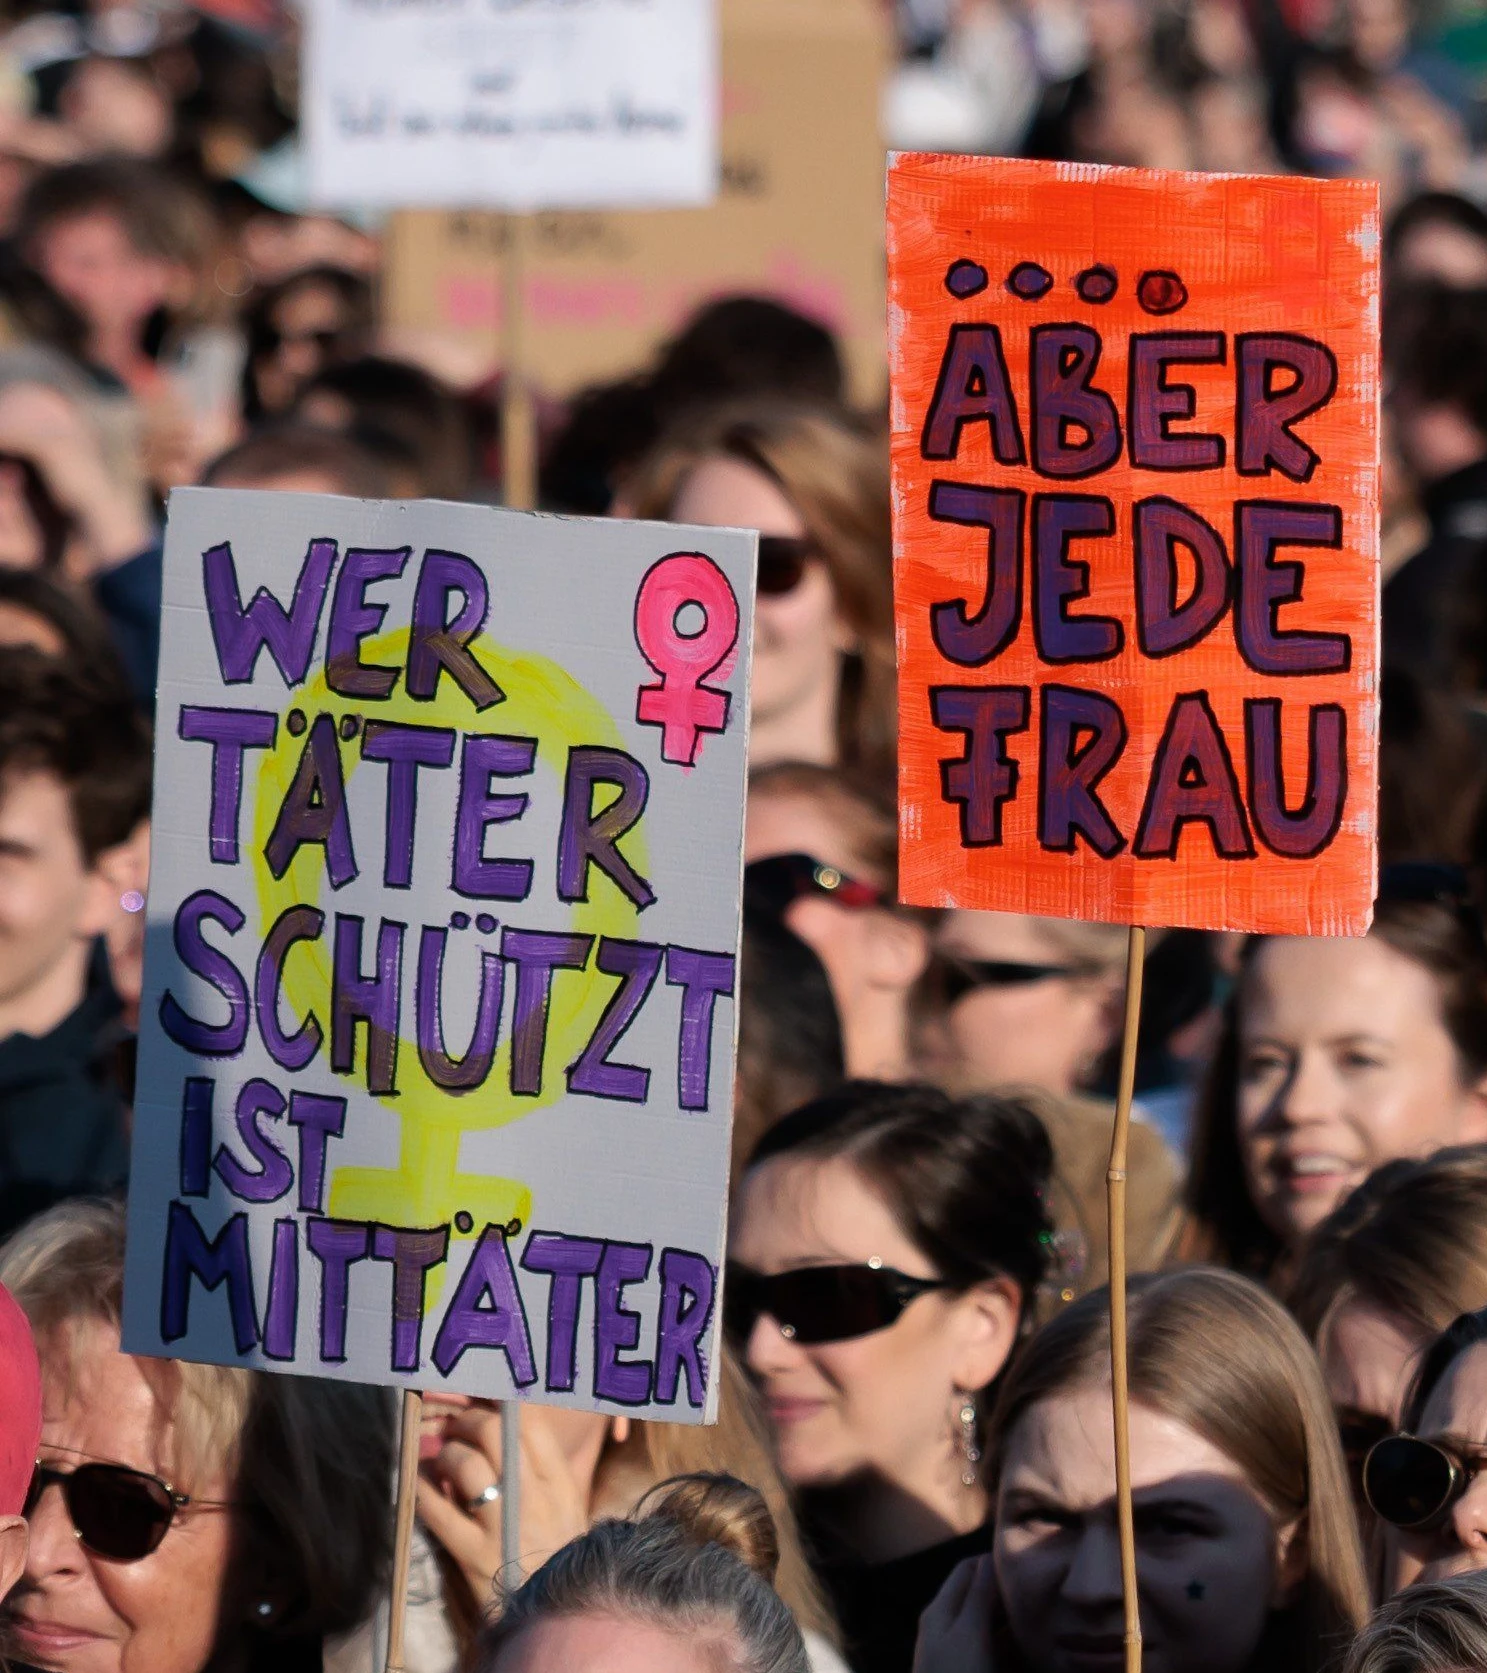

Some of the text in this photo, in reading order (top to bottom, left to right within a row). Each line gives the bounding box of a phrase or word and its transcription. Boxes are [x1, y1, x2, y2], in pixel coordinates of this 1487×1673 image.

[920, 320, 1339, 483] ABER
[202, 537, 508, 713] WER
[927, 479, 1352, 677] JEDE
[178, 704, 658, 912] TÄTER
[927, 682, 1350, 862] FRAU
[158, 887, 735, 1113] SCHÜTZT
[179, 1075, 347, 1213] IST
[159, 1202, 718, 1409] MITTÄTER
